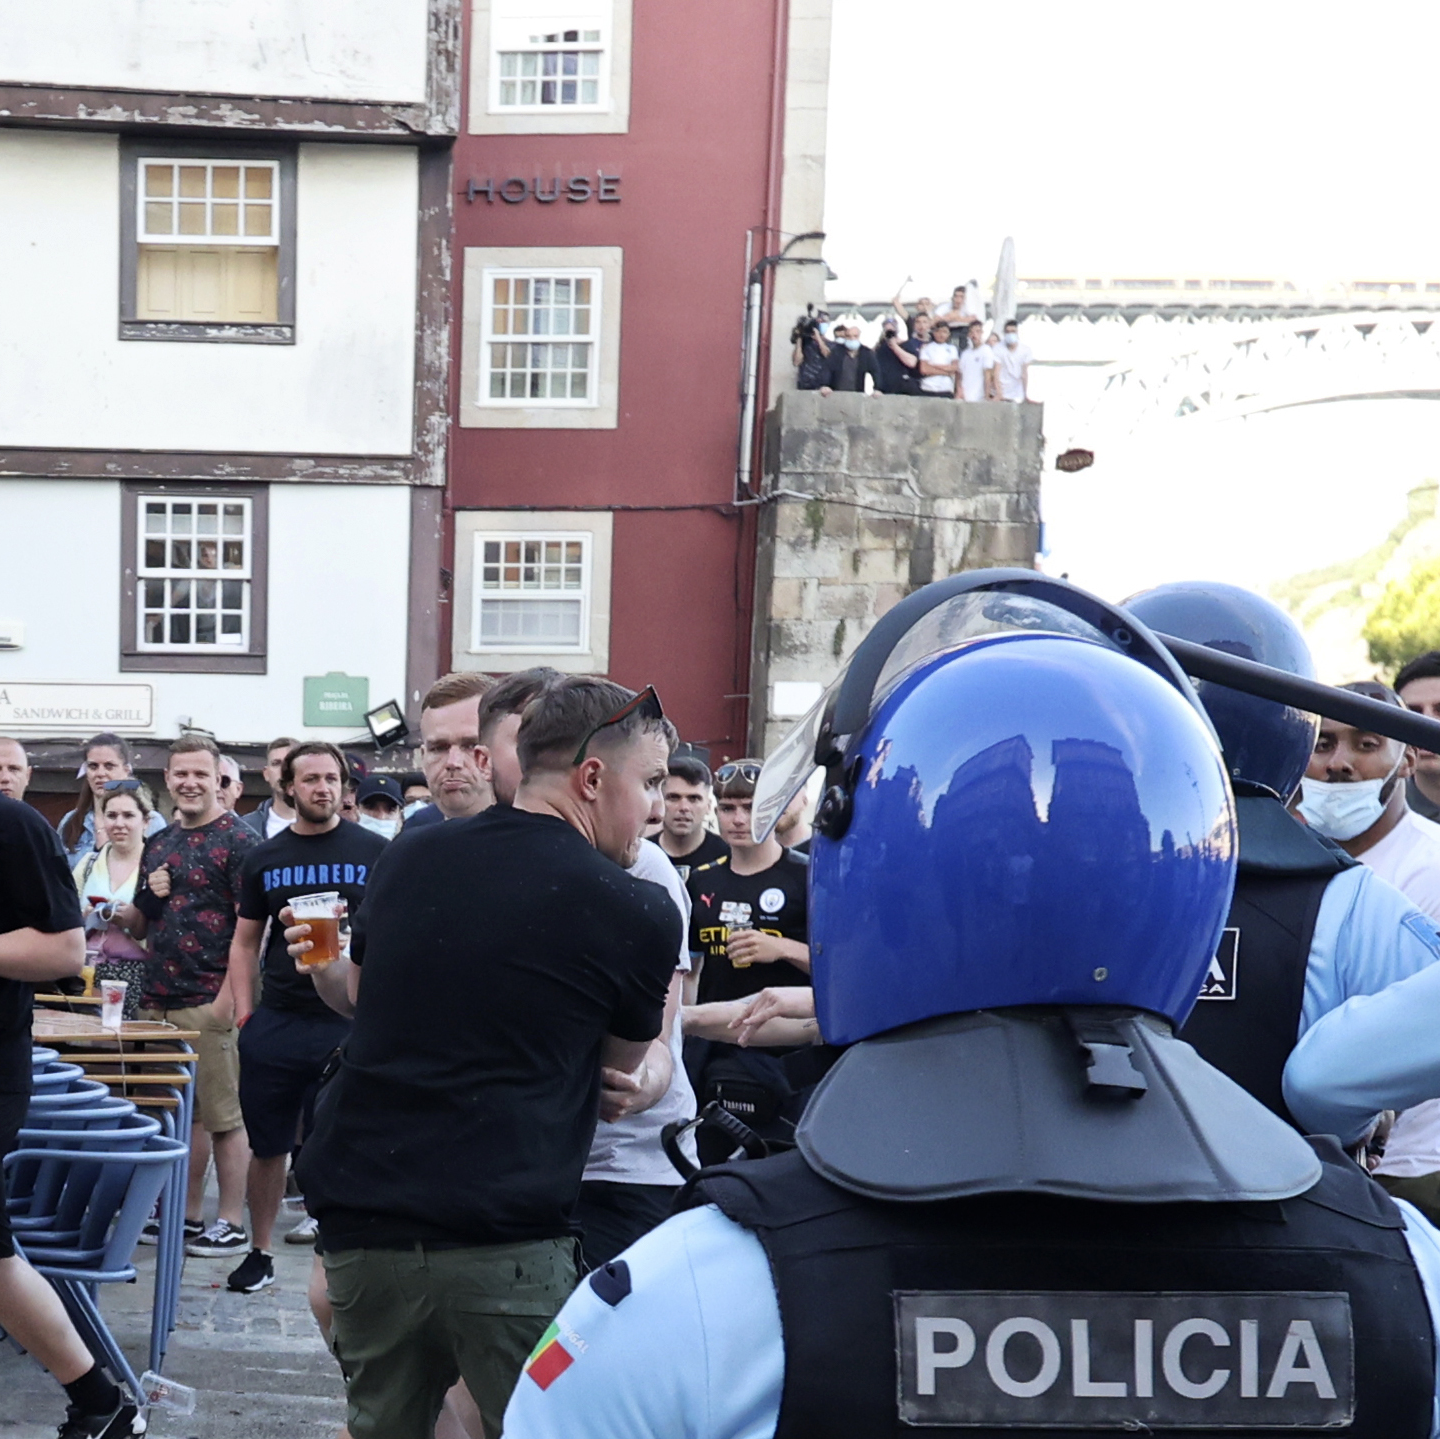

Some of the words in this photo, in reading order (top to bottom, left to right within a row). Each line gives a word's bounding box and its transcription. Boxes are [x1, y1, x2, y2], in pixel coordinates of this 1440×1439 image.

[467, 175, 622, 204] HOUSE
[13, 708, 89, 720] SANDWICH
[91, 709, 102, 719] &
[105, 709, 143, 721] GRILL
[916, 1316, 1338, 1399] POLICIA
